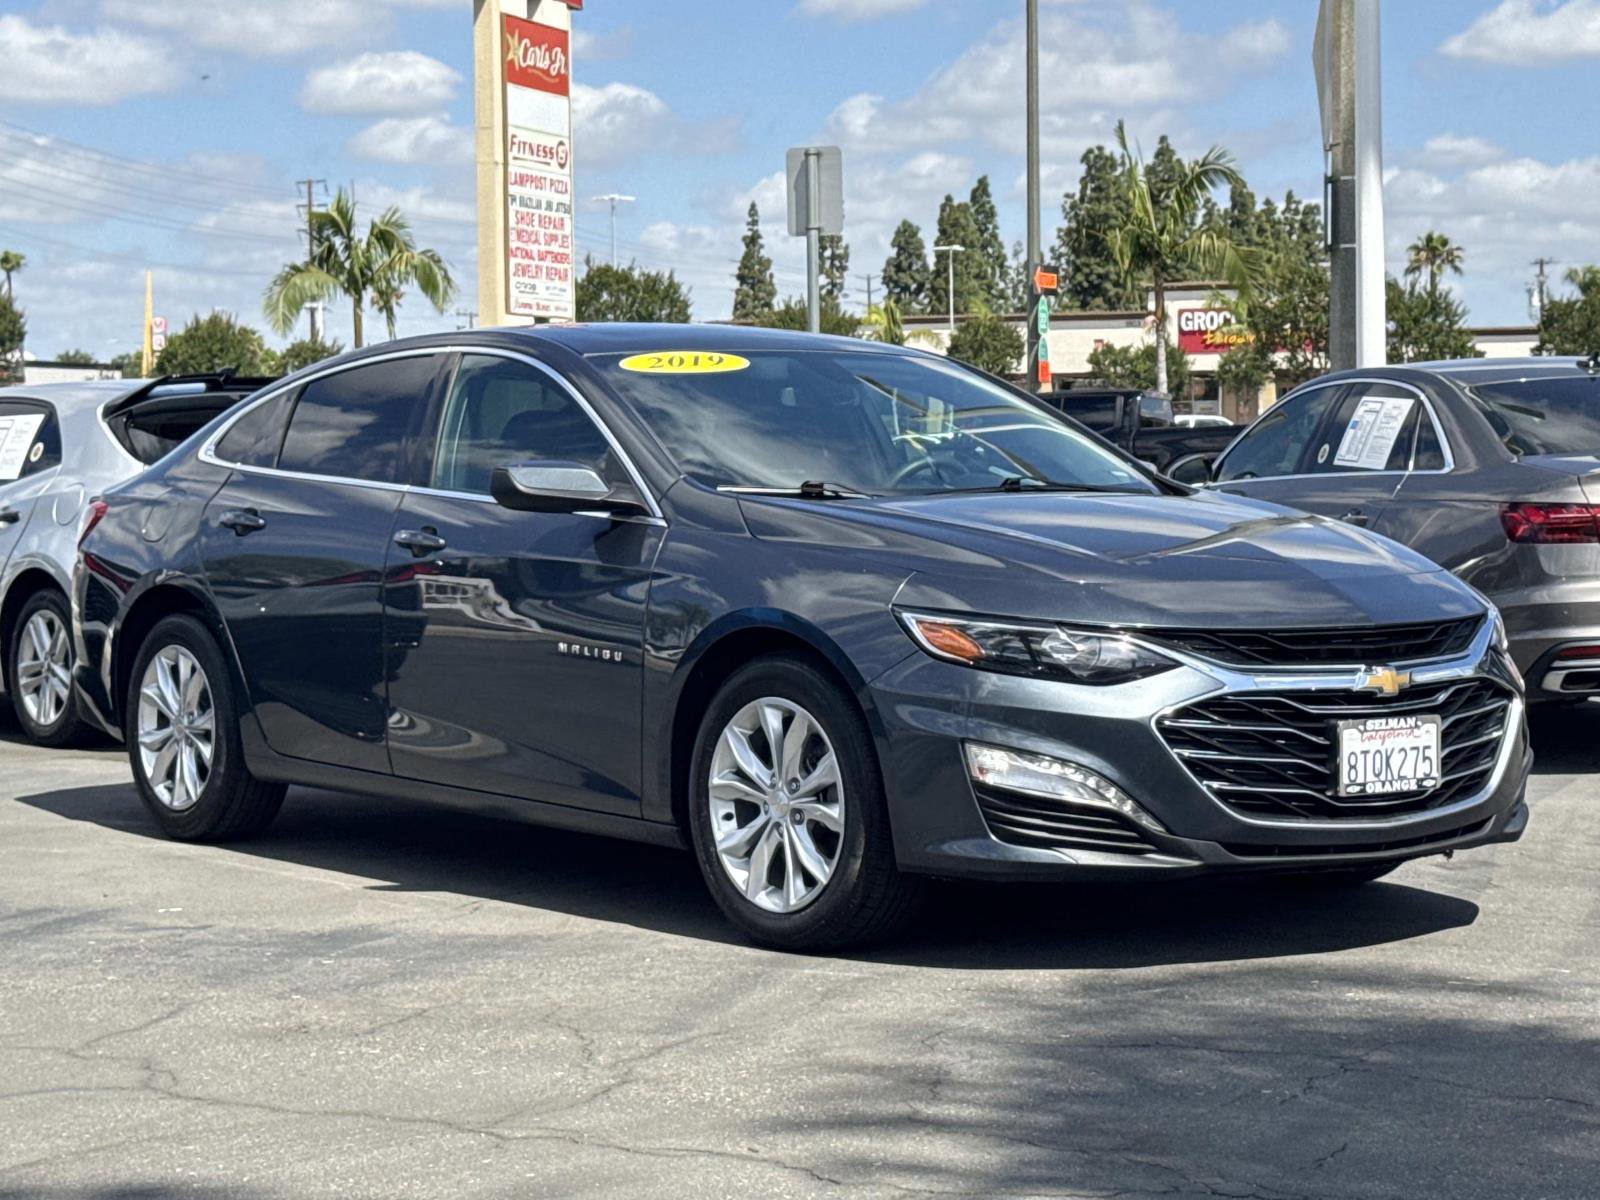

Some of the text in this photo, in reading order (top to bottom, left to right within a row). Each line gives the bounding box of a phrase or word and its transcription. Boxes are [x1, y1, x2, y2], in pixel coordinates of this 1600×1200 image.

[519, 38, 550, 70] Carl's
[509, 133, 555, 160] FITNESS
[509, 171, 568, 195] LAMPPOST PIZZA
[514, 210, 565, 231] SHOE REPAIR
[512, 262, 568, 282] JEWELRY REPAIR
[1180, 310, 1236, 331] GROC
[647, 355, 724, 368] 2019
[557, 642, 622, 662] MALIBU
[1365, 717, 1417, 730] SELMAN
[1347, 745, 1433, 783] 8TQK275
[1366, 779, 1418, 794] ORANGE
